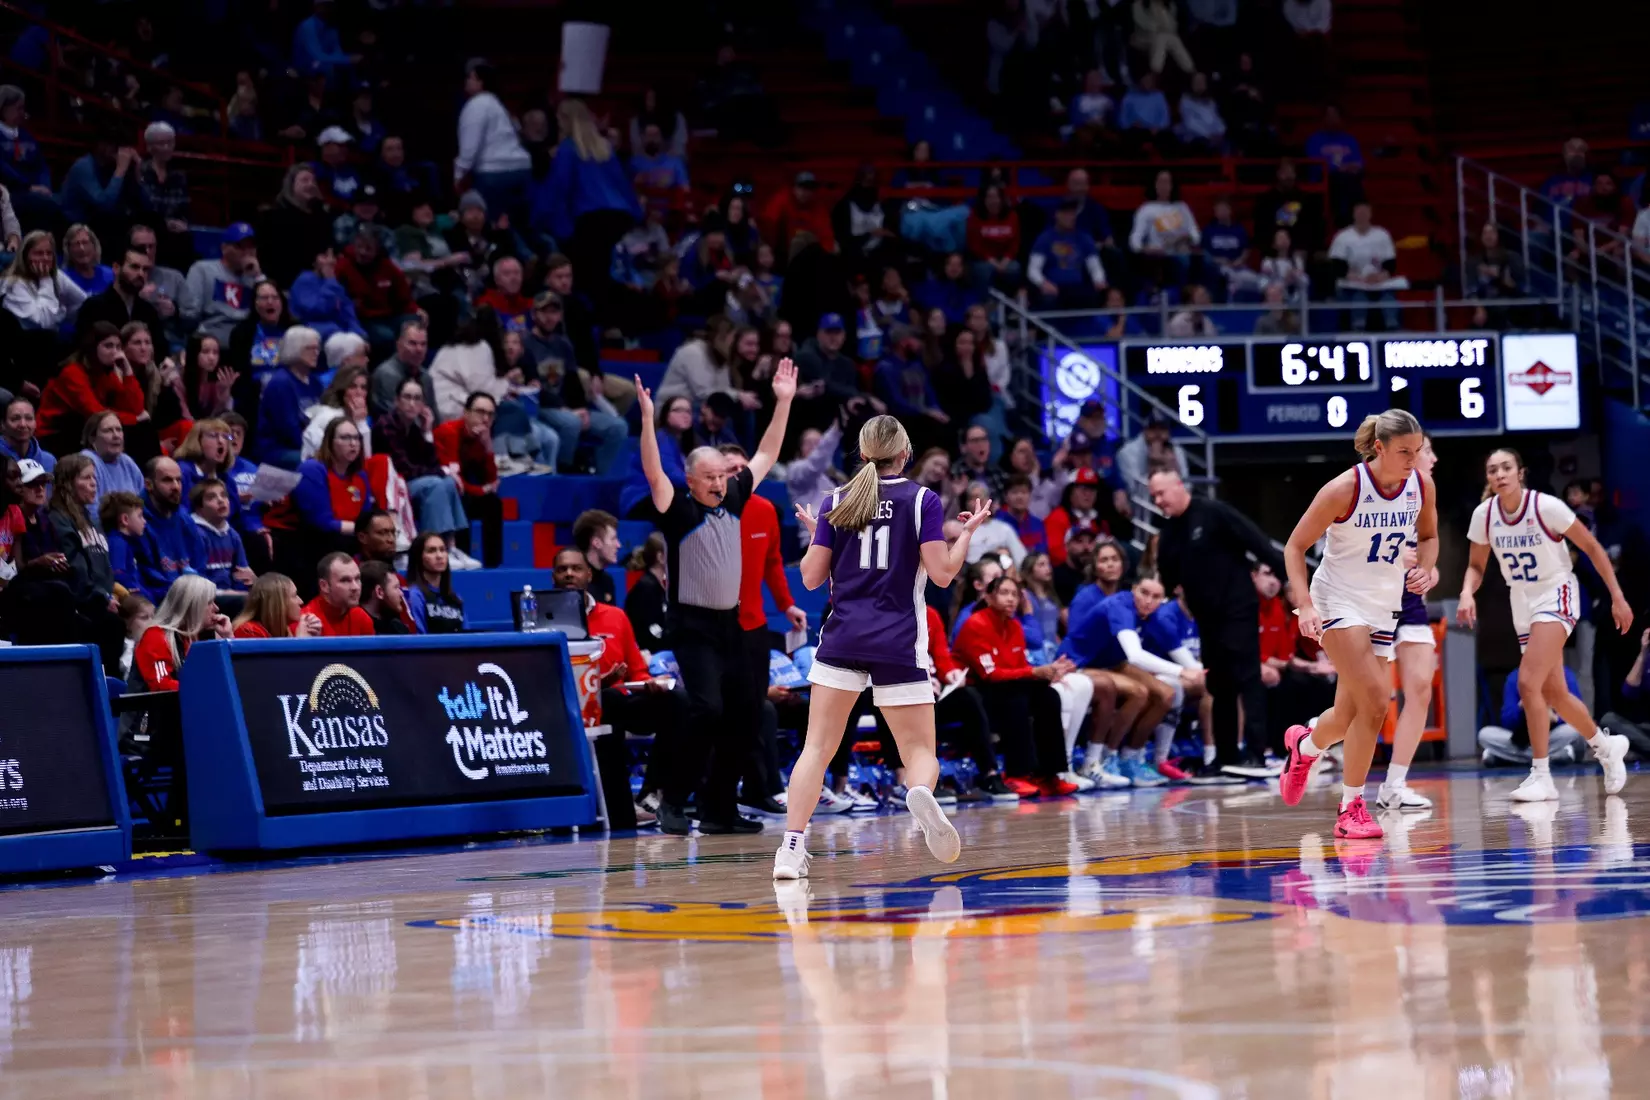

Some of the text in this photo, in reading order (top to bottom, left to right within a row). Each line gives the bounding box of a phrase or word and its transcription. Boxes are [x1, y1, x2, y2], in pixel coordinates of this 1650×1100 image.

[1281, 342, 1370, 385] 6:47
[1460, 339, 1488, 366] ST
[1178, 384, 1204, 426] 6
[1460, 377, 1485, 419] 6
[858, 525, 890, 570] 11
[1367, 532, 1406, 564] 13
[1495, 534, 1542, 549] AYHAWKS
[1502, 552, 1538, 581] 22
[584, 668, 600, 694] G
[438, 681, 487, 720] talk
[277, 694, 389, 758] Kansas
[462, 725, 547, 760] Matters
[300, 757, 384, 777] Department for Aging
[303, 775, 390, 792] and Disability Services
